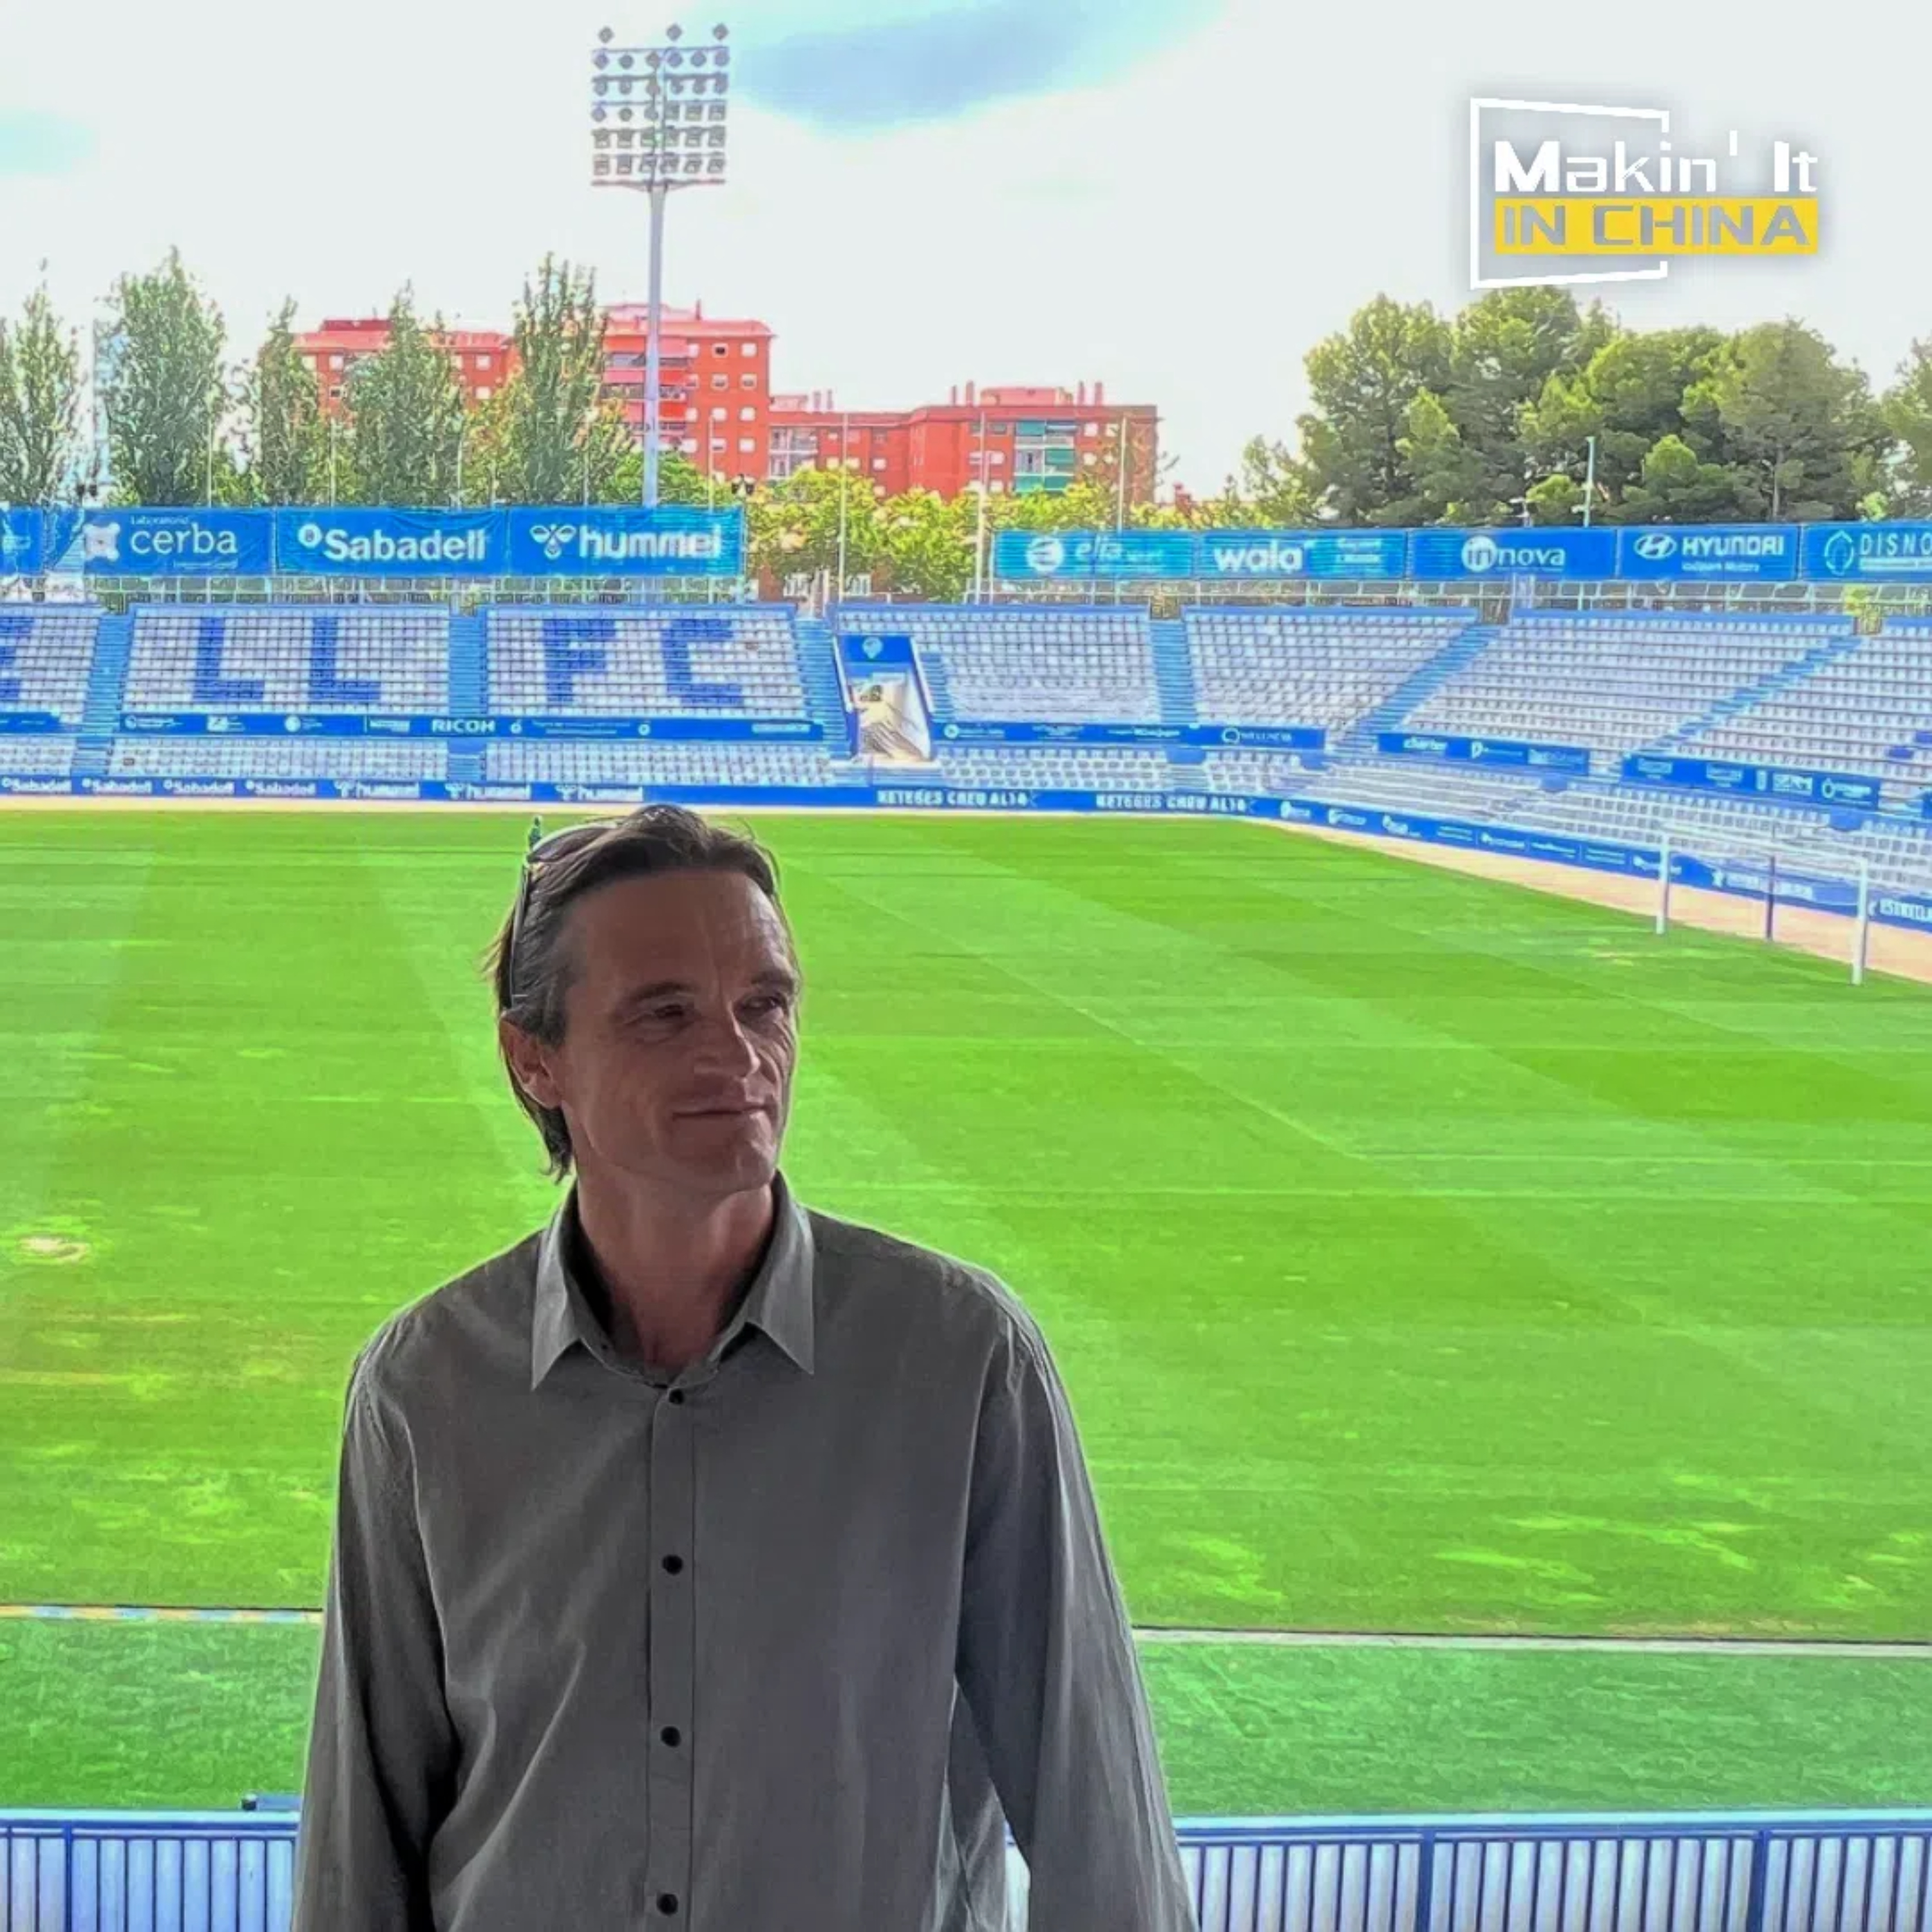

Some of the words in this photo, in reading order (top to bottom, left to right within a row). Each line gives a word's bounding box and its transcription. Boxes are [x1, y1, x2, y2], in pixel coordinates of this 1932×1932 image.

[130, 522, 238, 554] cerba
[323, 529, 486, 560] Sabadell
[580, 524, 721, 558] hummel
[1682, 536, 1785, 556] HYUNDAI
[431, 718, 496, 733] RICOH
